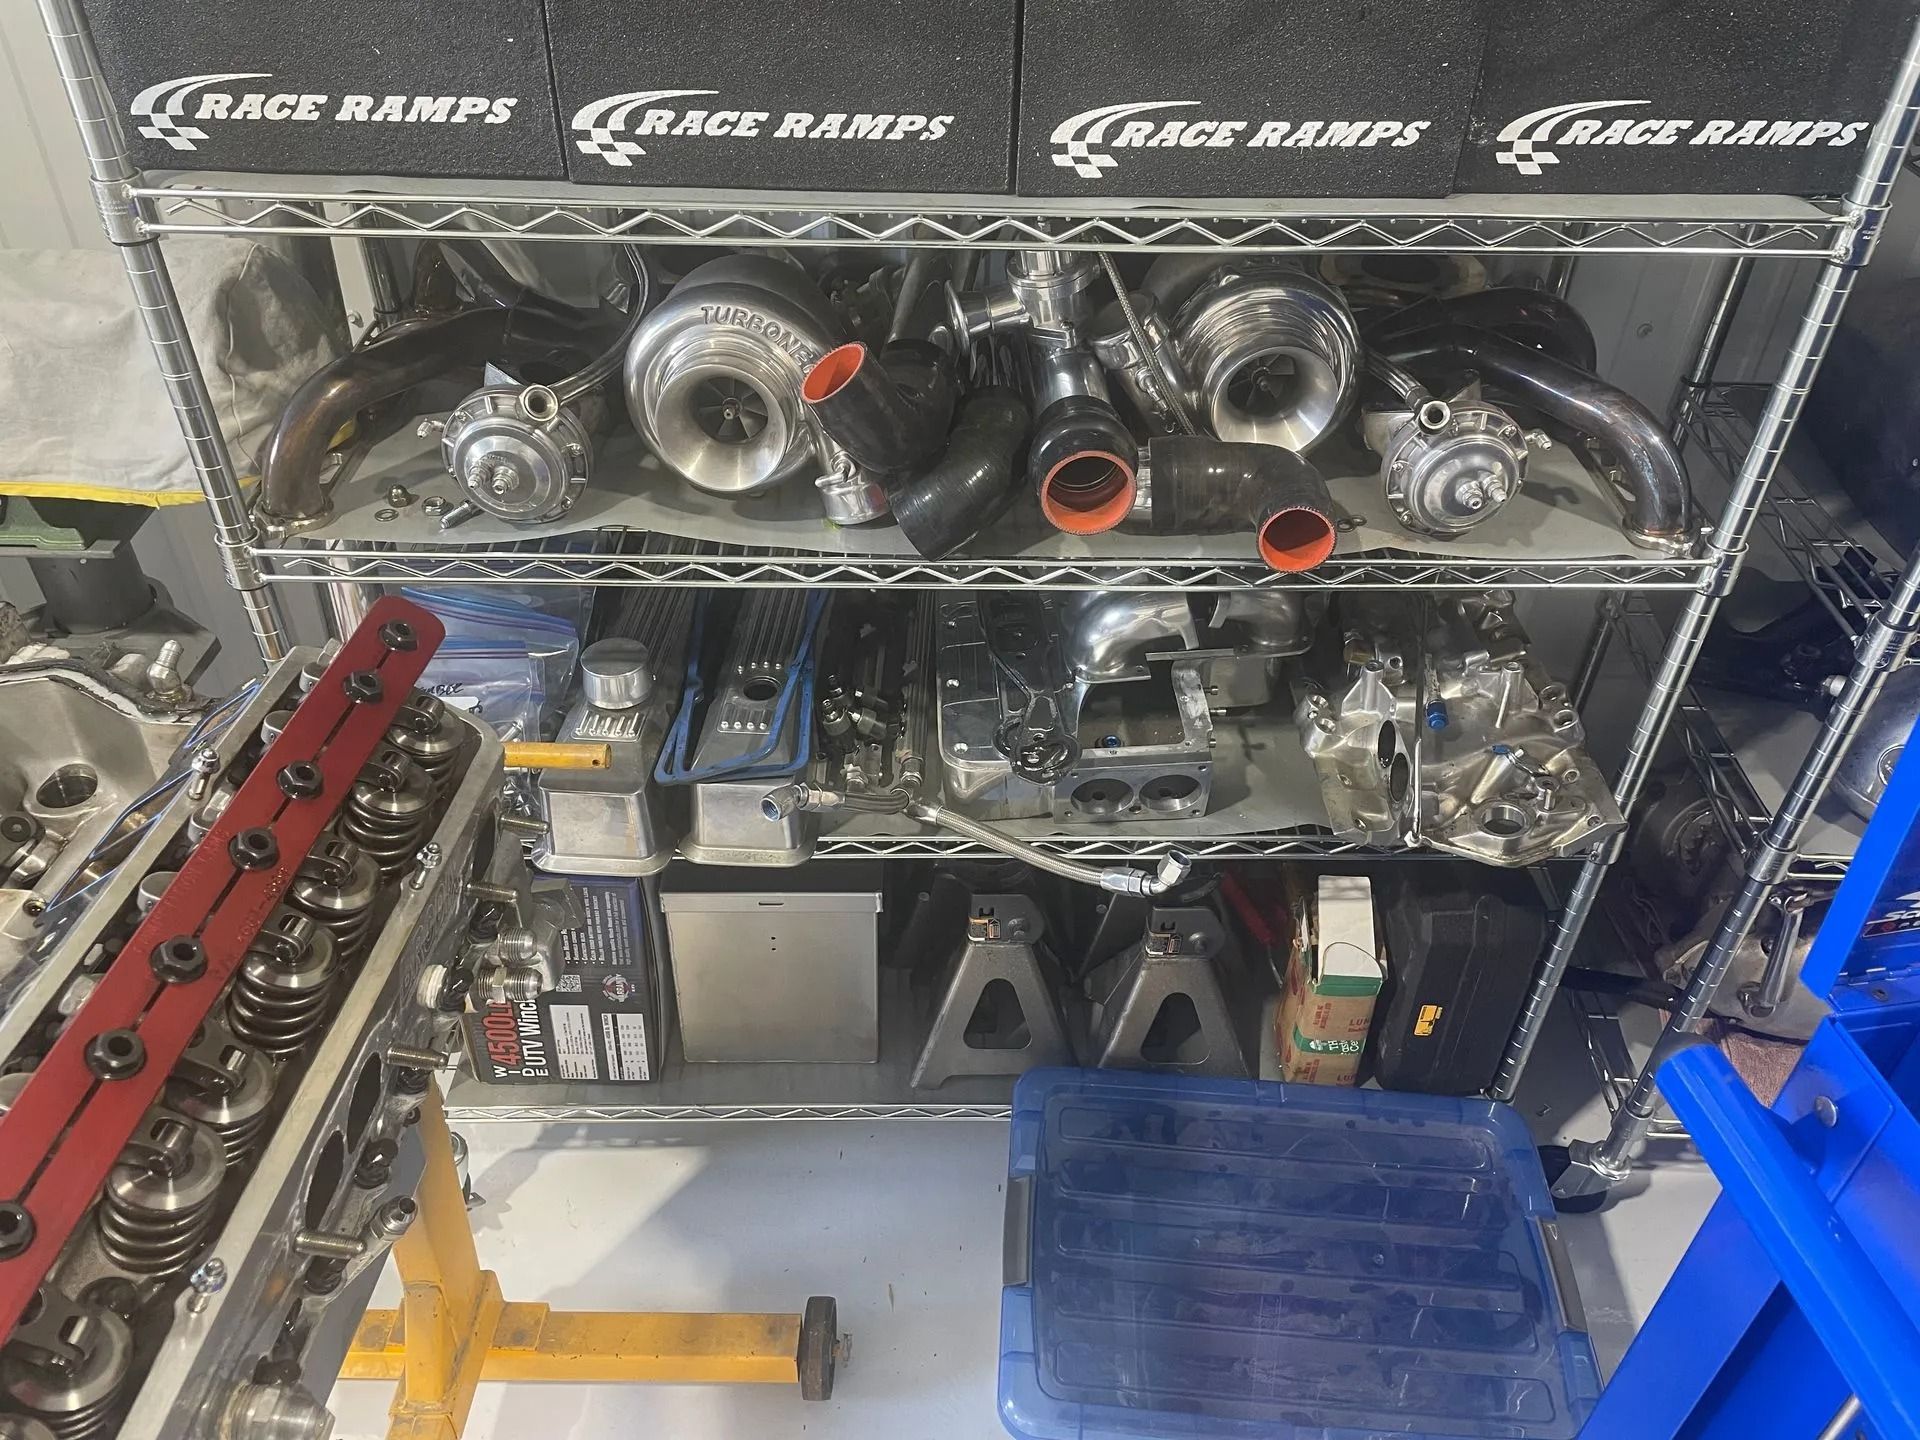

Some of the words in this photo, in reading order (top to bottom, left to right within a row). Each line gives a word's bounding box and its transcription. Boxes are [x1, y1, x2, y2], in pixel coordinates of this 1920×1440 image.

[193, 93, 329, 121] RACE
[334, 94, 519, 125] RAMPS
[634, 108, 769, 138] RACE
[772, 112, 955, 141] RAMPS
[1110, 120, 1248, 148] RACE
[1246, 120, 1432, 149] RAMPS
[1556, 119, 1694, 146] RACE
[1688, 119, 1870, 147] RAMPS
[700, 304, 816, 375] TURBONE
[520, 1039, 548, 1067] UTV
